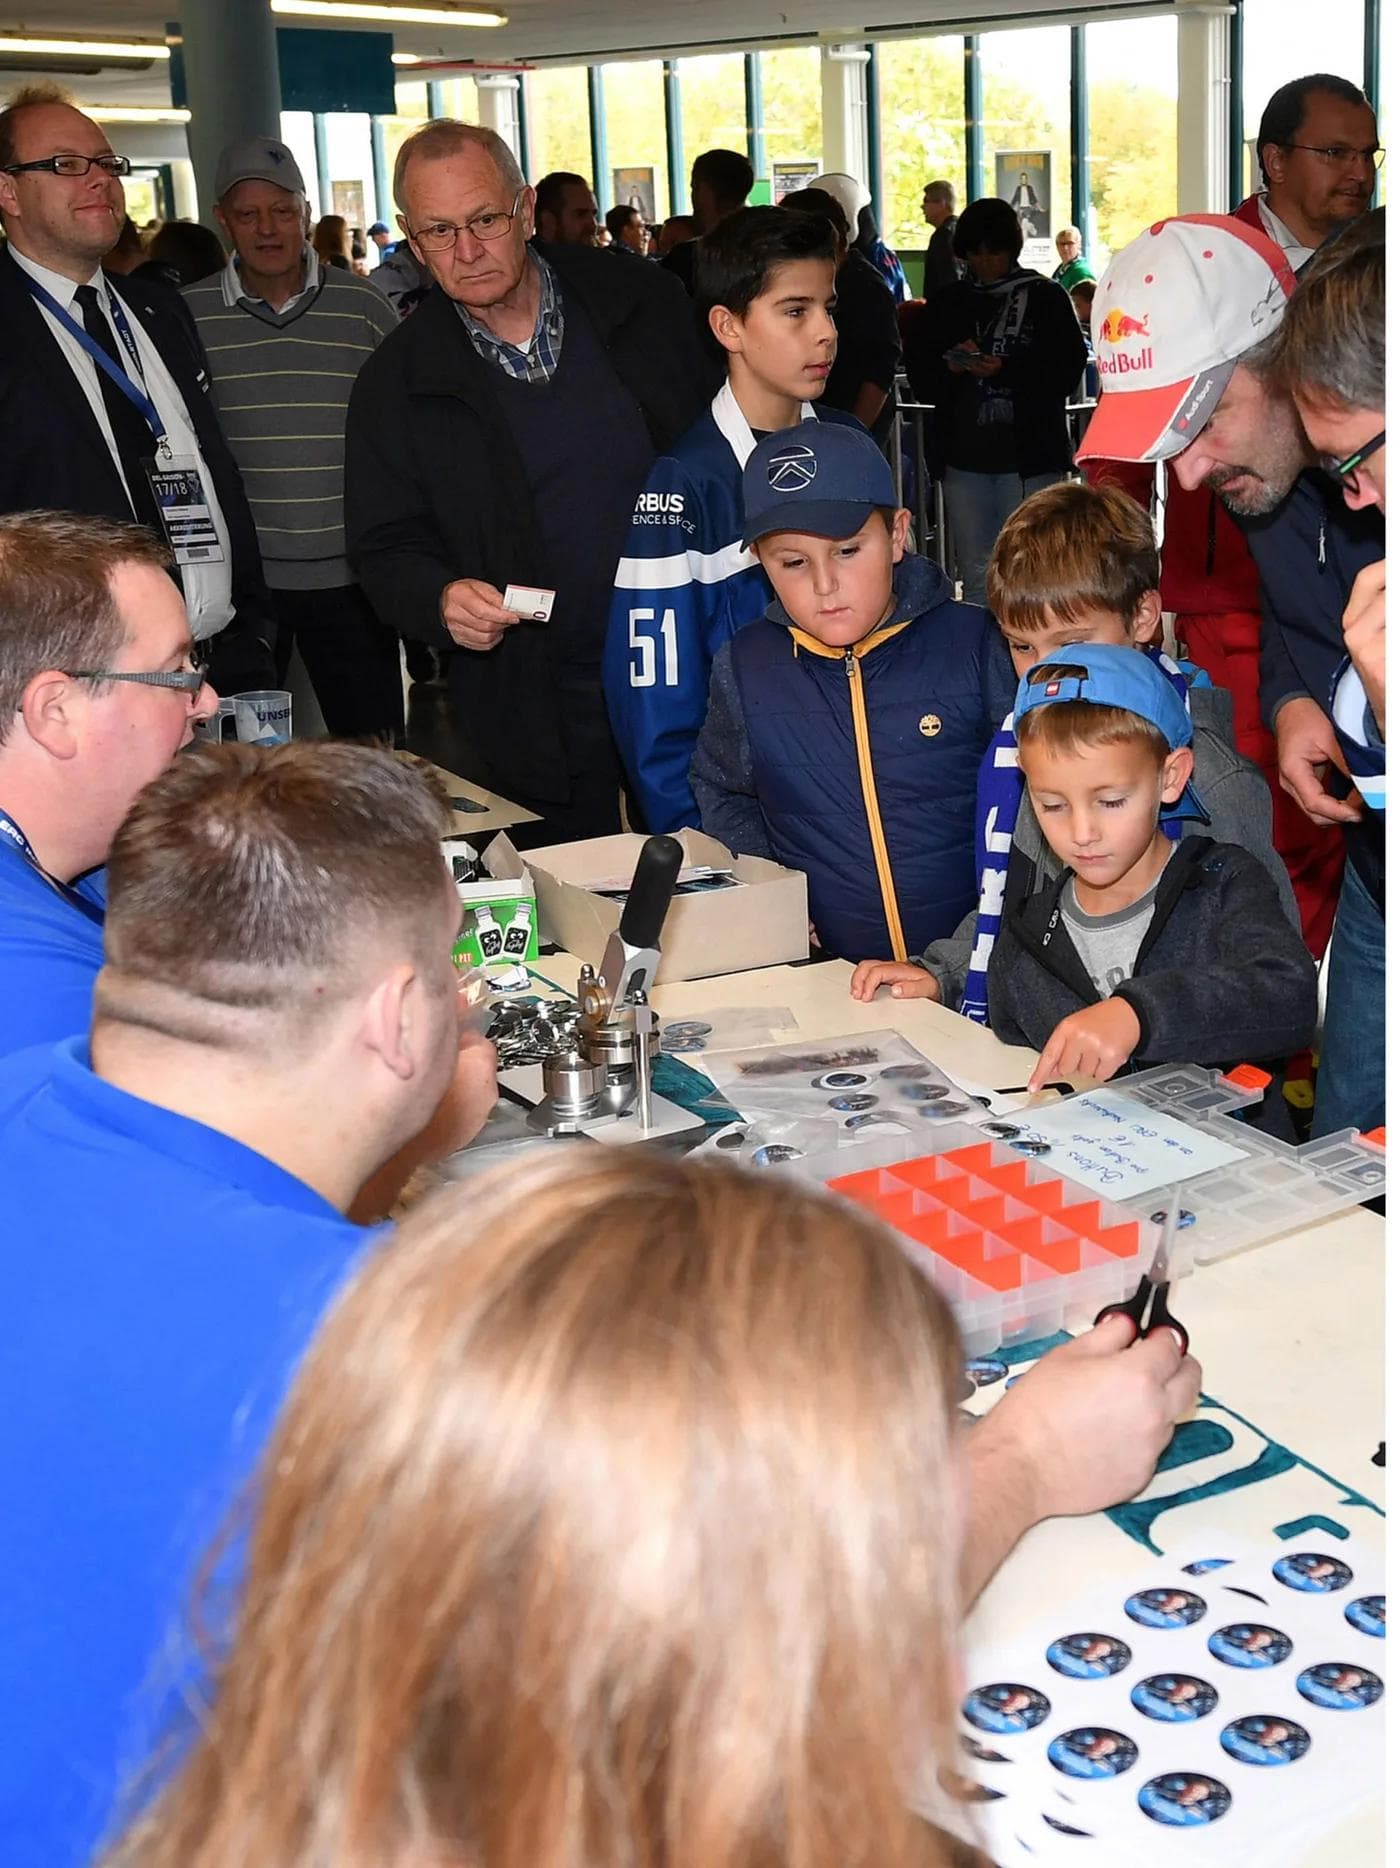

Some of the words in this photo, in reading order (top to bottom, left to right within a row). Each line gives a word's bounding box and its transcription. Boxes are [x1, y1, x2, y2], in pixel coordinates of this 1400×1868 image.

[1118, 347, 1153, 373] Bull
[1186, 401, 1202, 421] Audi
[156, 482, 188, 497] 17/18
[629, 608, 679, 687] 51
[1069, 1151, 1124, 1184] Buttons
